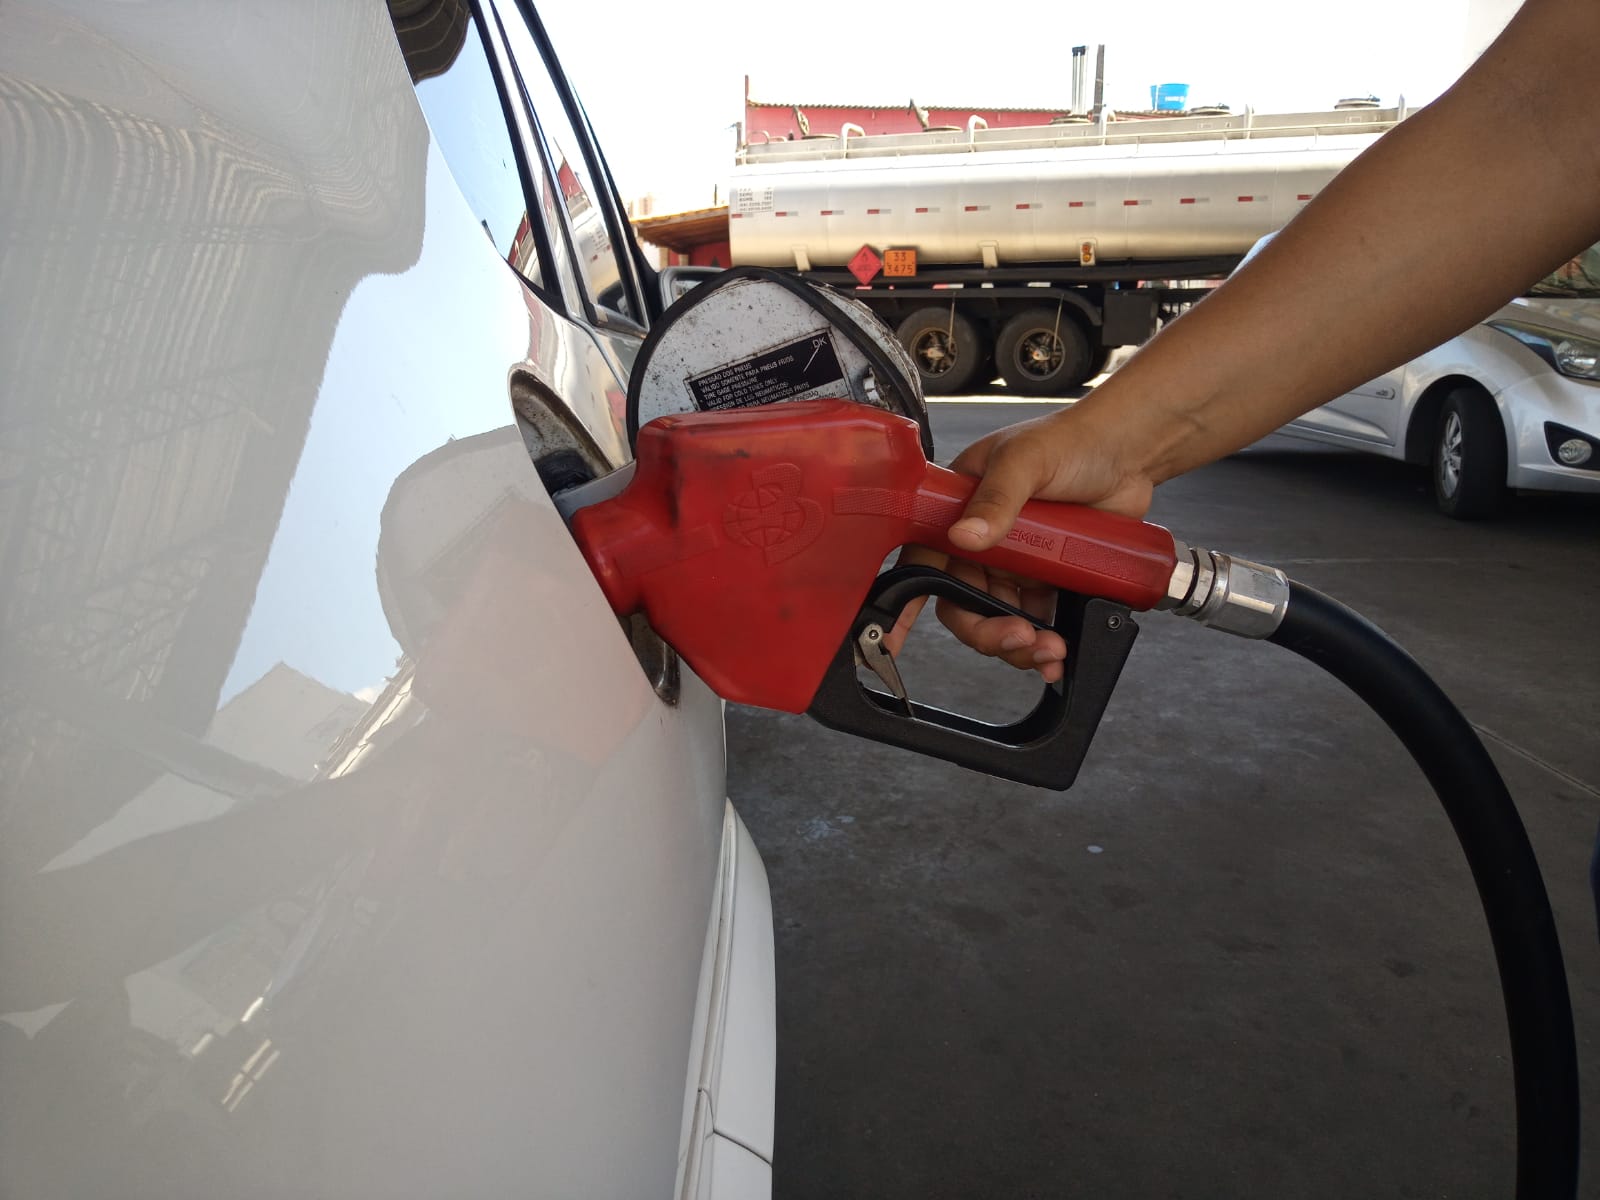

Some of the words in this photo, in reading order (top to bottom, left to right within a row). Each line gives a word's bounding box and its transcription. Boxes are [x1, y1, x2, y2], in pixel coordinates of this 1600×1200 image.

[893, 252, 906, 262] 33
[887, 264, 913, 275] 3475
[760, 361, 777, 372] PNEUS
[778, 355, 794, 366] FRIOS
[1006, 528, 1056, 551] EMEN
